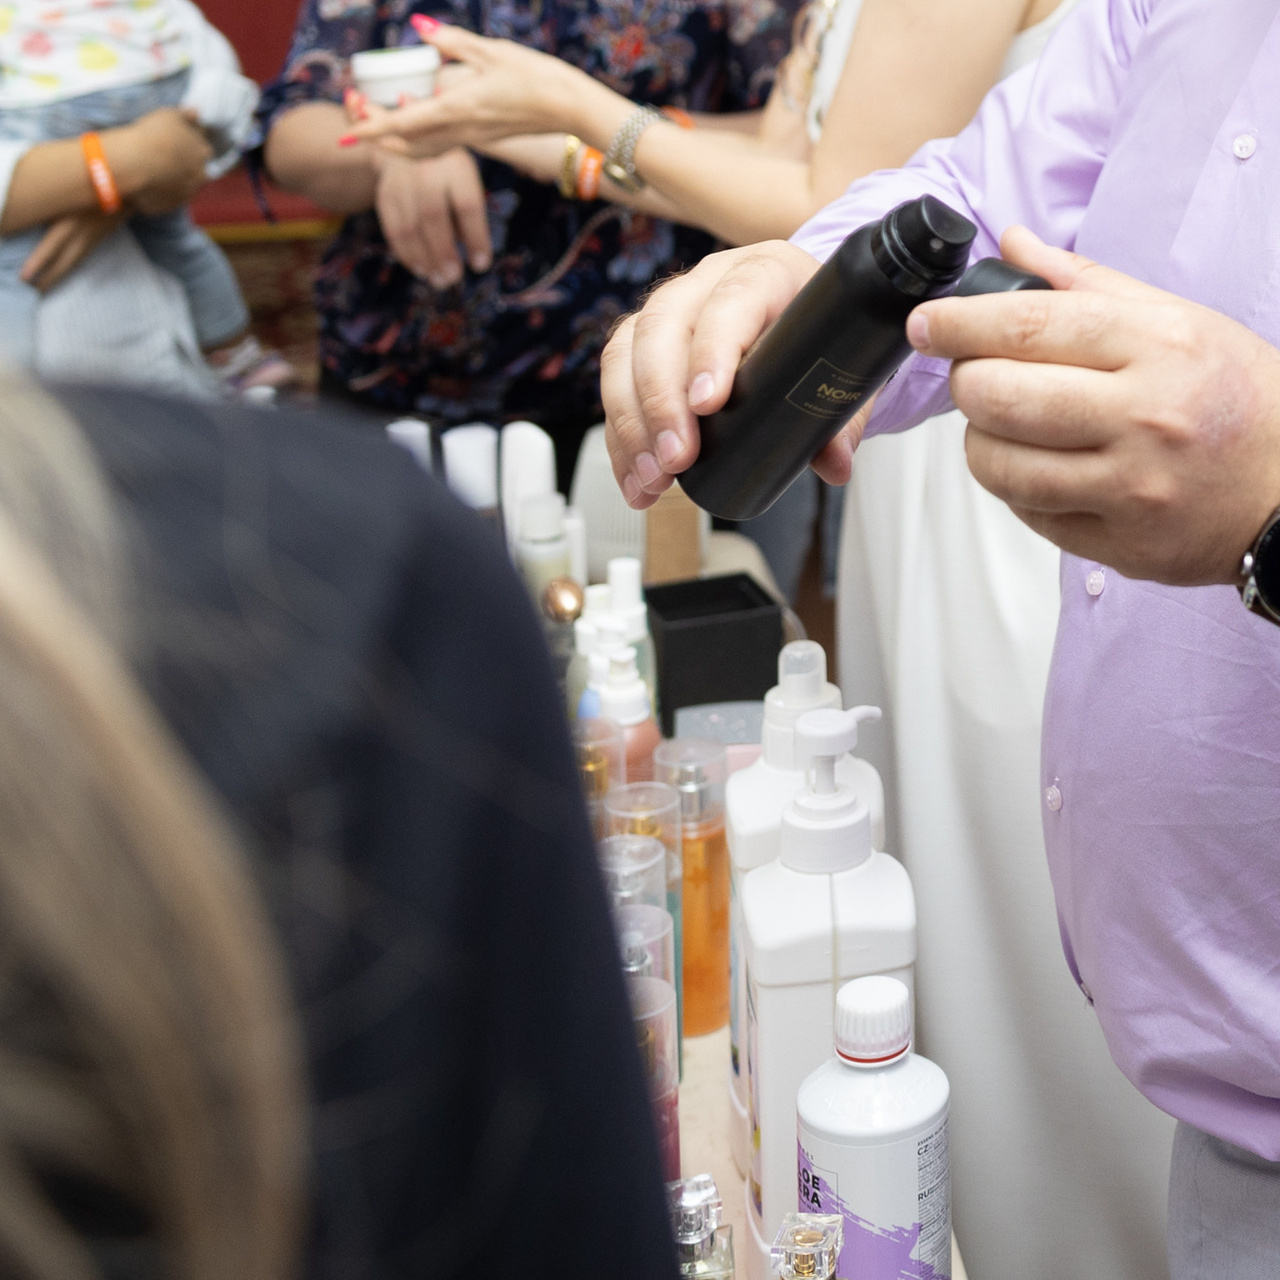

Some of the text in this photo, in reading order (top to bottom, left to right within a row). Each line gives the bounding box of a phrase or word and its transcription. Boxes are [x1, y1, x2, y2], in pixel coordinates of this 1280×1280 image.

[817, 383, 862, 400] NOIR
[917, 1144, 929, 1156] CZ
[917, 1189, 930, 1201] RU
